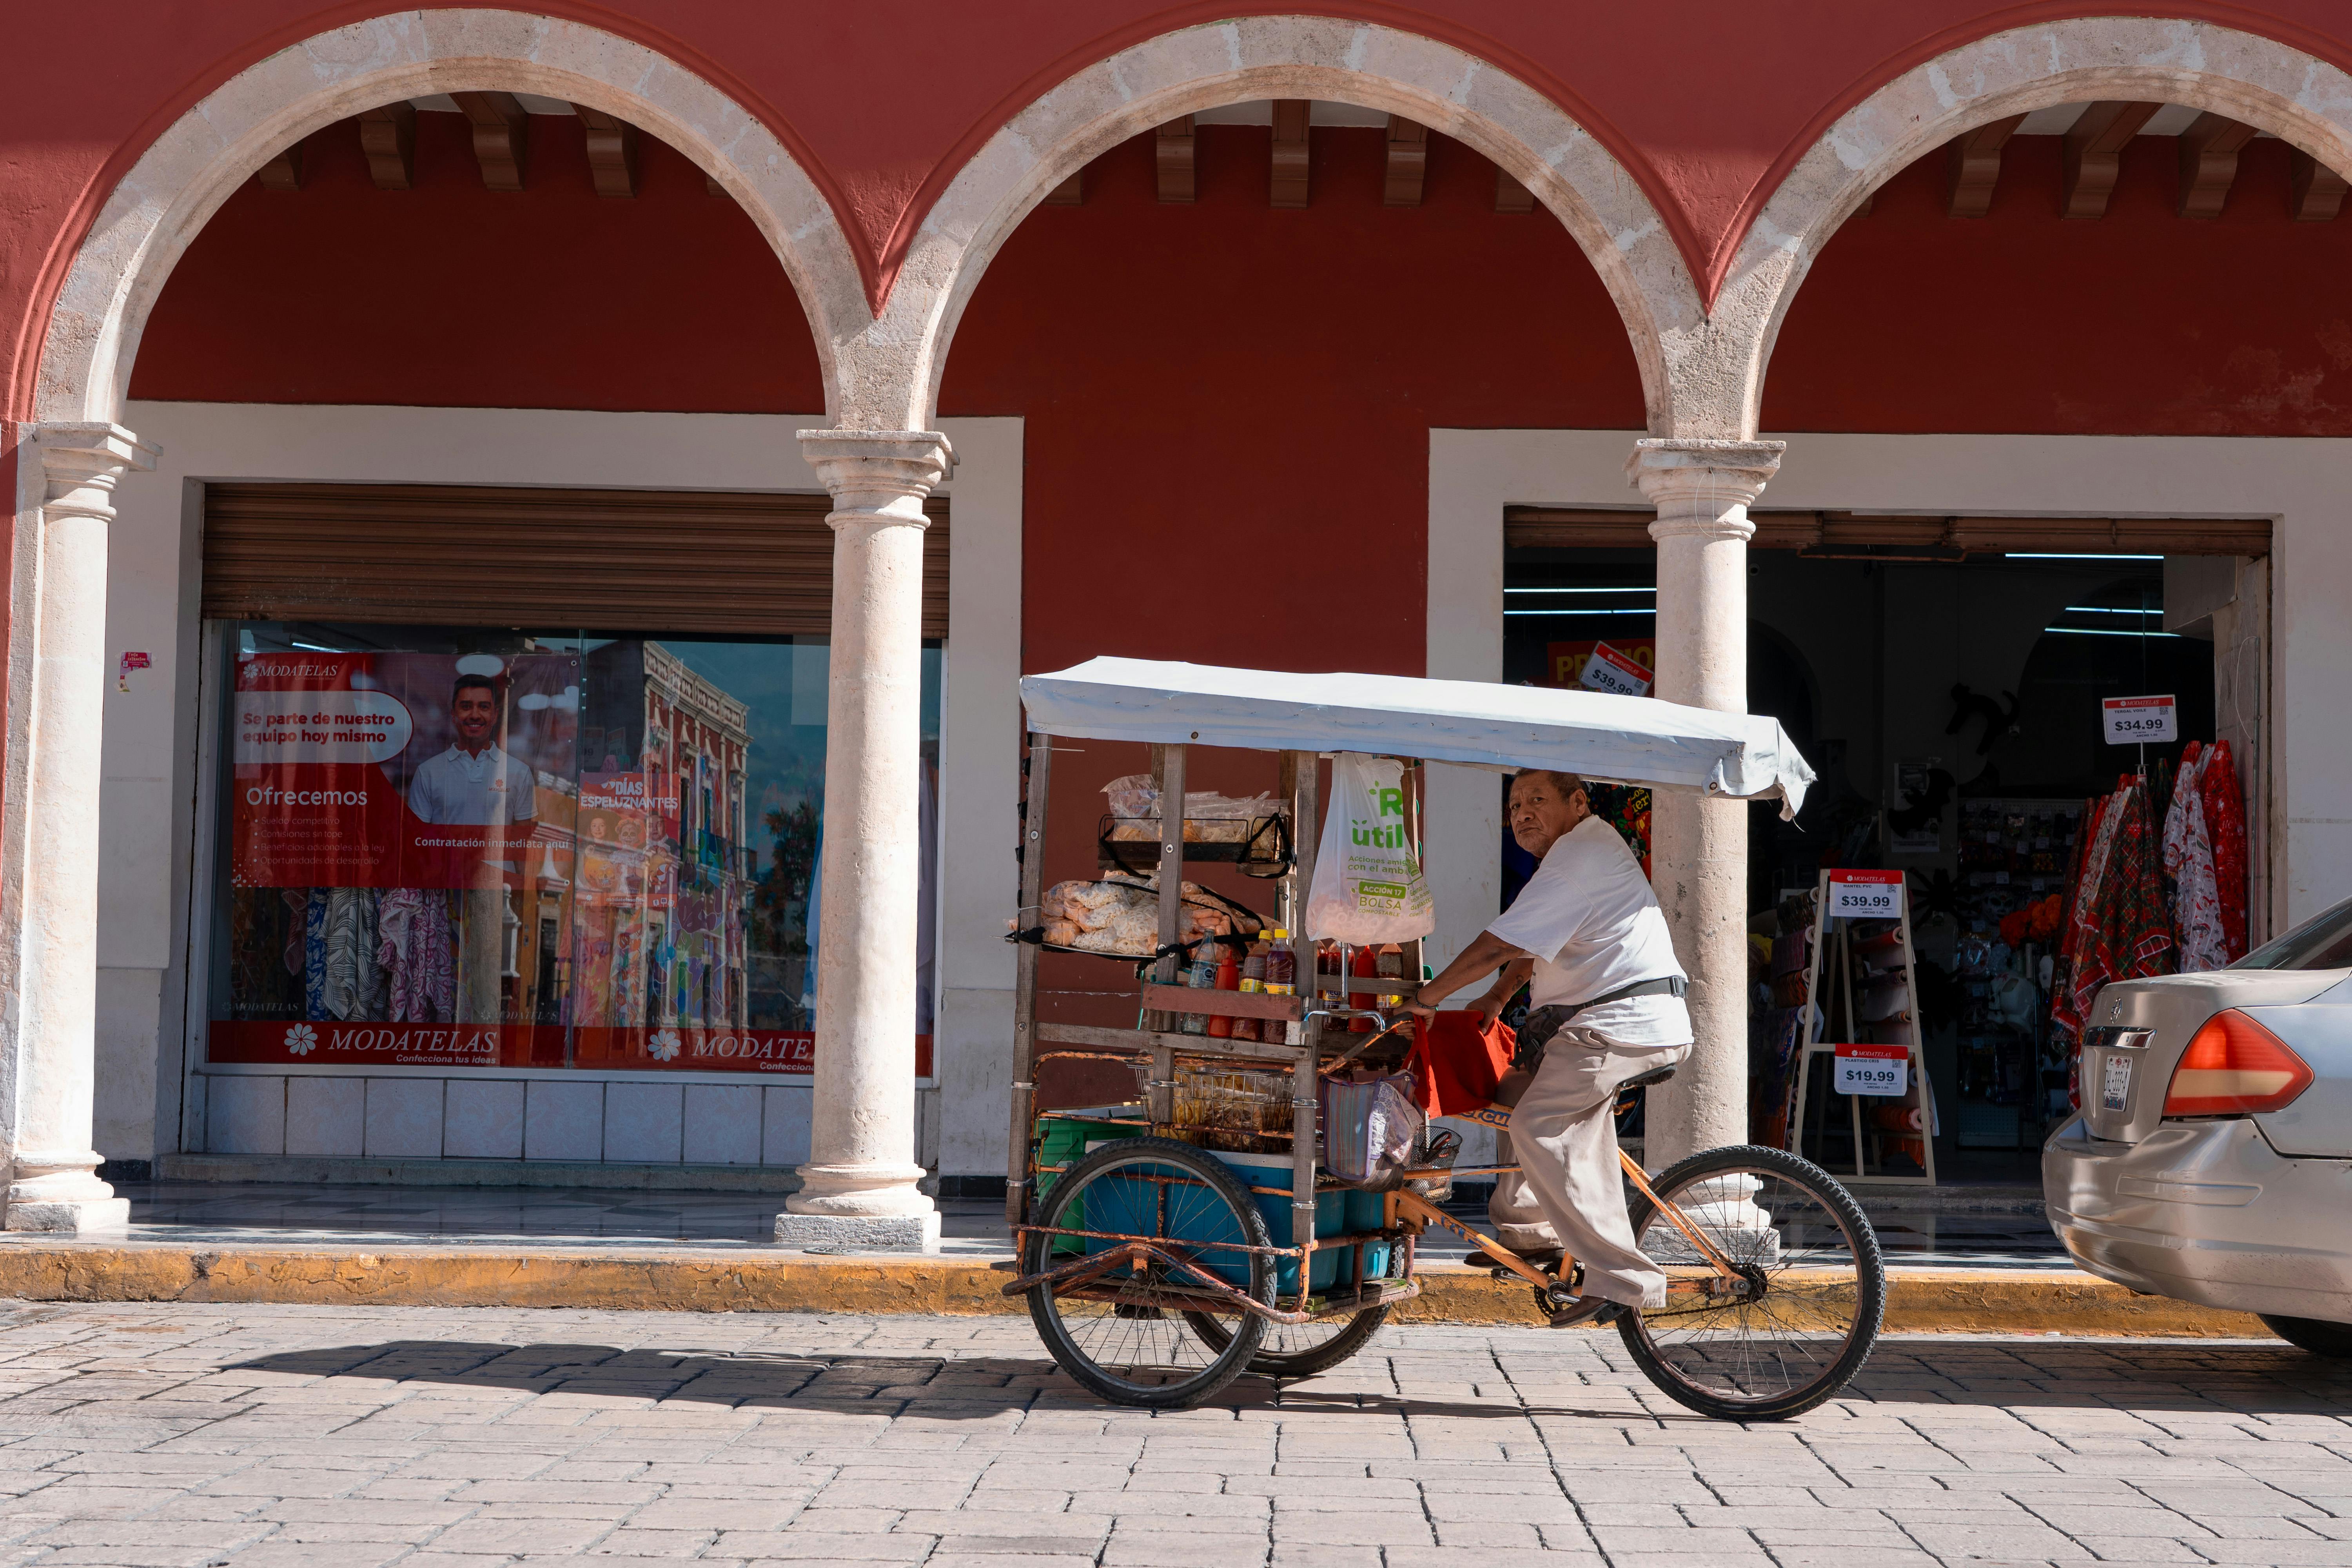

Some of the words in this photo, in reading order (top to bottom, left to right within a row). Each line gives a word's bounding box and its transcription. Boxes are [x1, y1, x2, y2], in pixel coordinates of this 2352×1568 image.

[259, 665, 338, 677] MODATELAS
[1605, 661, 1621, 673] MINIMAT
[1613, 657, 1639, 675] MODATELAS
[1592, 669, 1633, 695] $39.99
[243, 713, 262, 725] Se
[267, 714, 307, 727] parte
[312, 712, 330, 725] de
[335, 713, 395, 725] nuestro
[2115, 719, 2163, 731] $34.99
[243, 729, 297, 744] equipo
[301, 729, 329, 744] hoy
[333, 730, 386, 742] mismo
[615, 777, 643, 795] DÍAS
[247, 786, 367, 805] Ofrecemos
[581, 796, 678, 809] ESPELUZNANTES
[292, 817, 339, 826] competitivo
[372, 844, 385, 853] ley
[415, 837, 485, 847] Contratación
[488, 838, 543, 848] inmediata
[546, 839, 569, 851] aquí
[260, 857, 322, 865] Oportunidades
[1349, 856, 1385, 864] Acciones
[1363, 886, 1393, 895] ACCIÓN
[1359, 897, 1401, 910] BOLSA
[1841, 895, 1890, 906] $39.99
[1358, 908, 1400, 917] COMPOSTABLE
[235, 1003, 299, 1011] MODATELAS
[328, 1029, 497, 1053] MODATELAS
[691, 1036, 815, 1060] MODATE
[396, 1054, 452, 1063] Confecciona
[760, 1062, 815, 1071] Confecciona
[1846, 1070, 1895, 1082] $19.99
